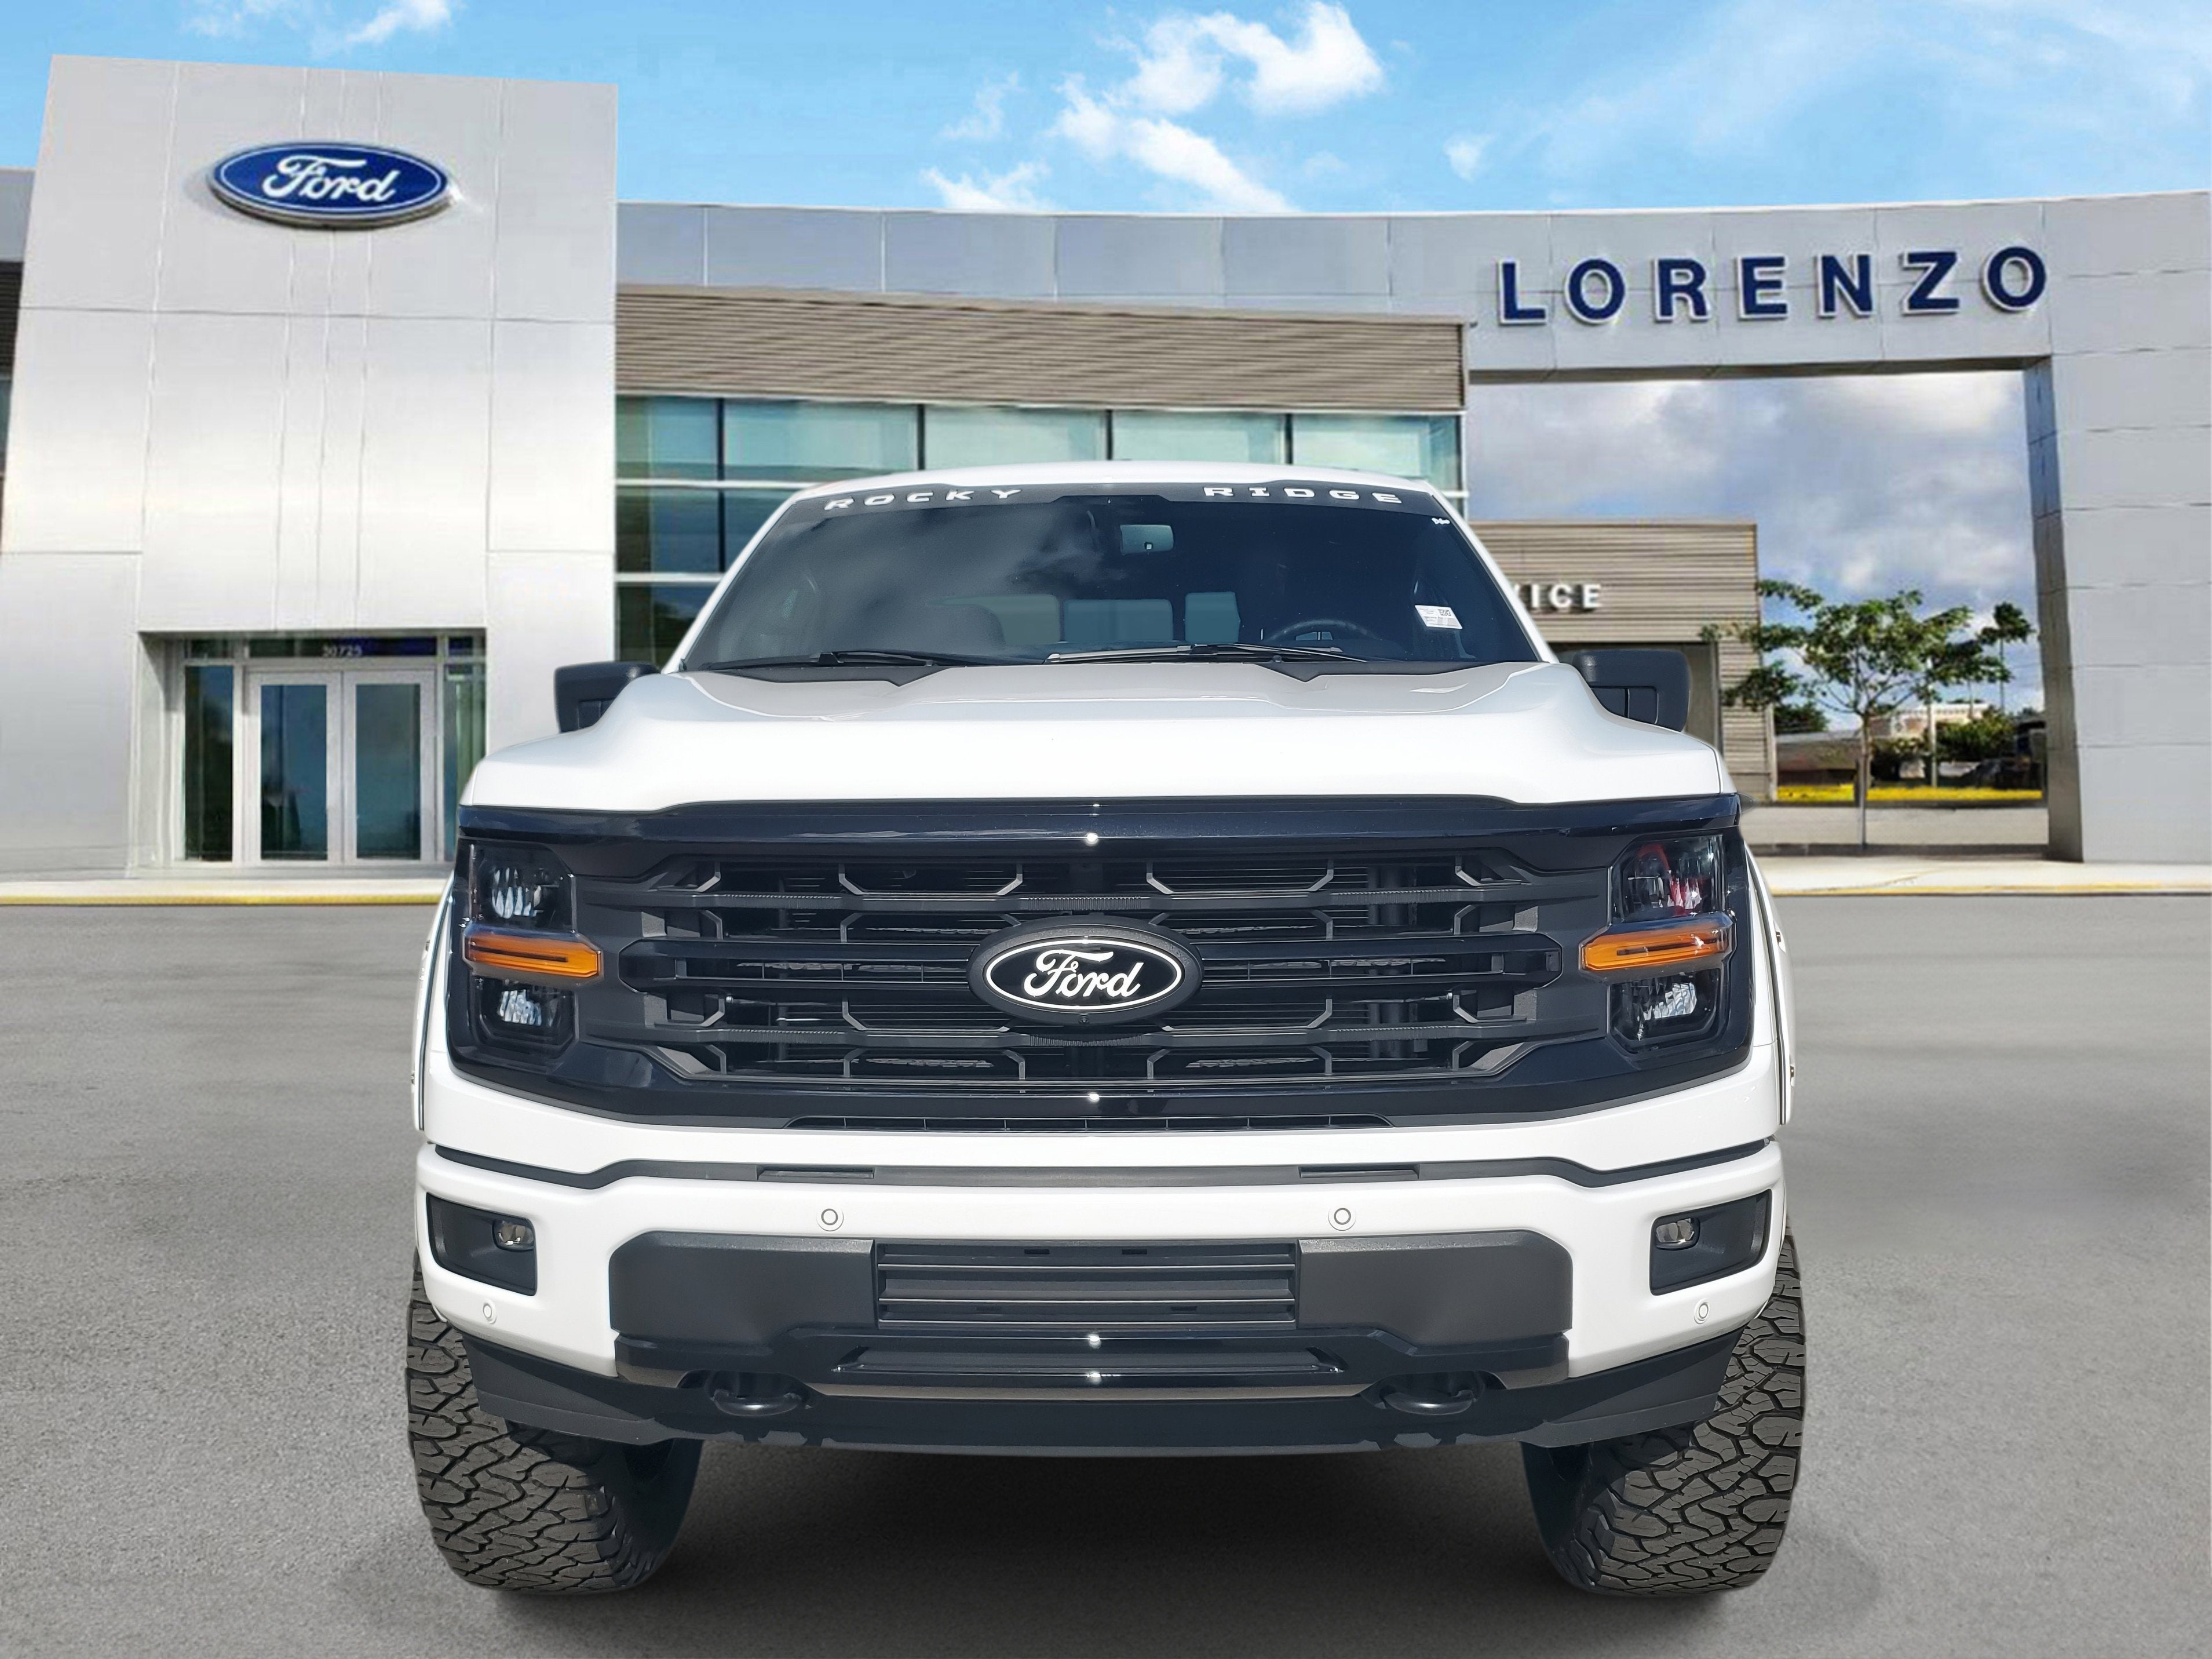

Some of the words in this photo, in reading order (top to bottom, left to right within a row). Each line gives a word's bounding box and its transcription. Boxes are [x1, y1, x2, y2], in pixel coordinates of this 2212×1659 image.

[262, 155, 400, 202] Ford
[1498, 246, 2047, 326] LORENZO
[824, 488, 1022, 511] ROCKY
[1203, 486, 1403, 504] RIDGE
[1514, 583, 1603, 609] ICE
[1023, 949, 1145, 998] Ford
